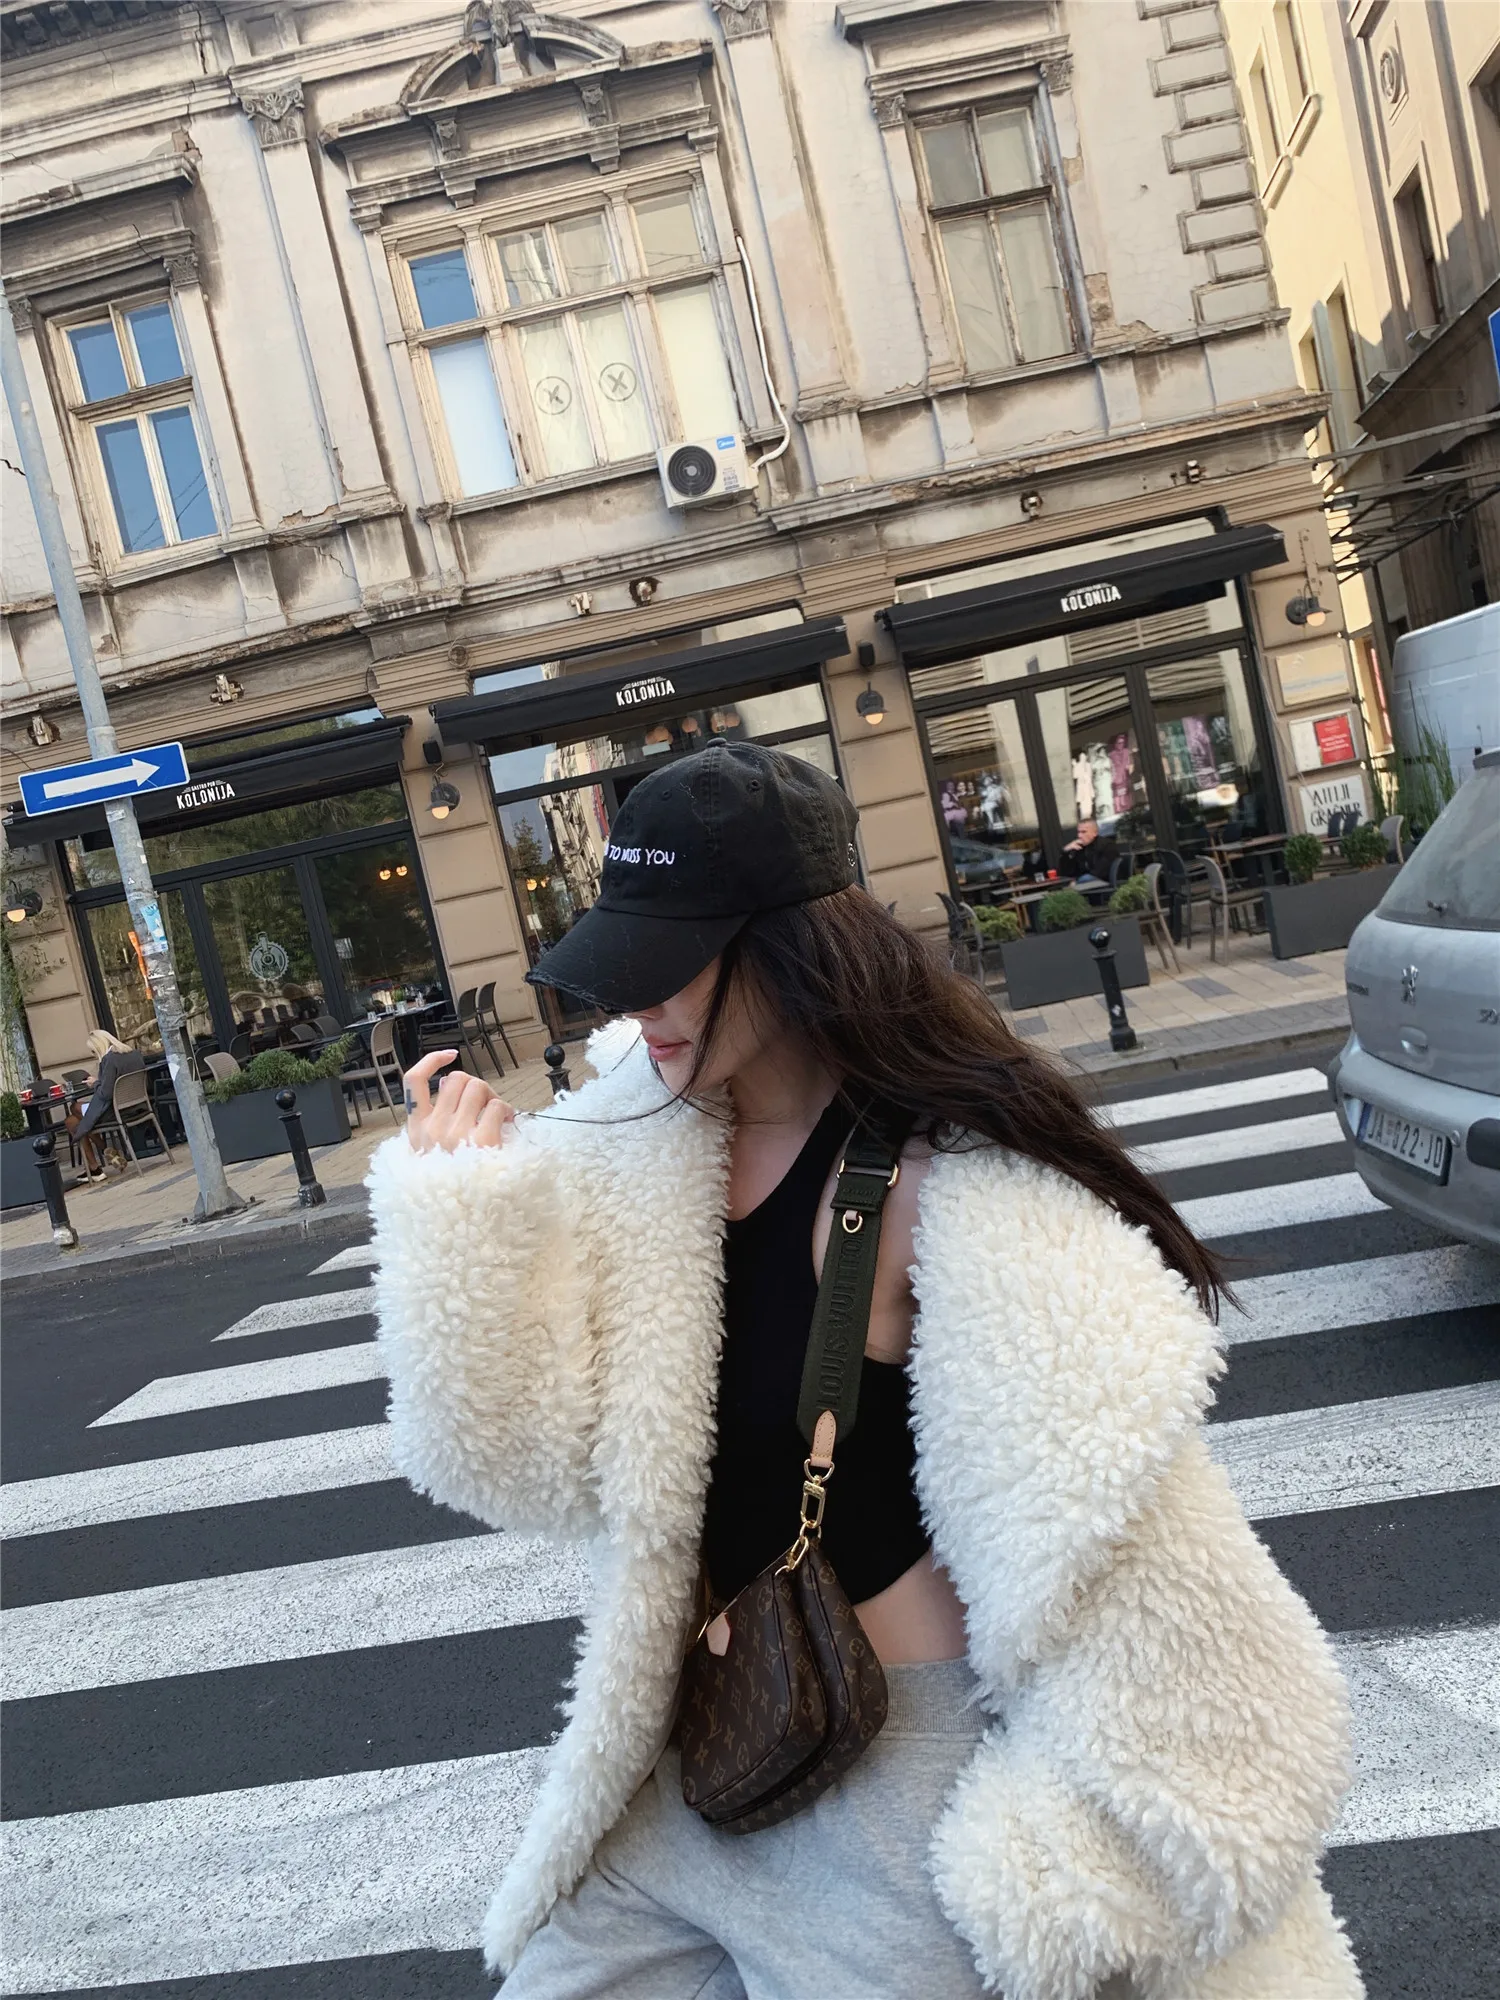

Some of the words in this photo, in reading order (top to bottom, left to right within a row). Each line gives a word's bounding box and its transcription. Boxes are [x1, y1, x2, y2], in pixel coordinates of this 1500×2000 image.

[1060, 585, 1122, 613] KOLONIJA
[615, 679, 676, 706] KOLONIJA
[176, 783, 236, 809] KOLONIJA
[608, 844, 620, 860] TO
[645, 848, 675, 866] YOU
[815, 1336, 851, 1413] LOUIS
